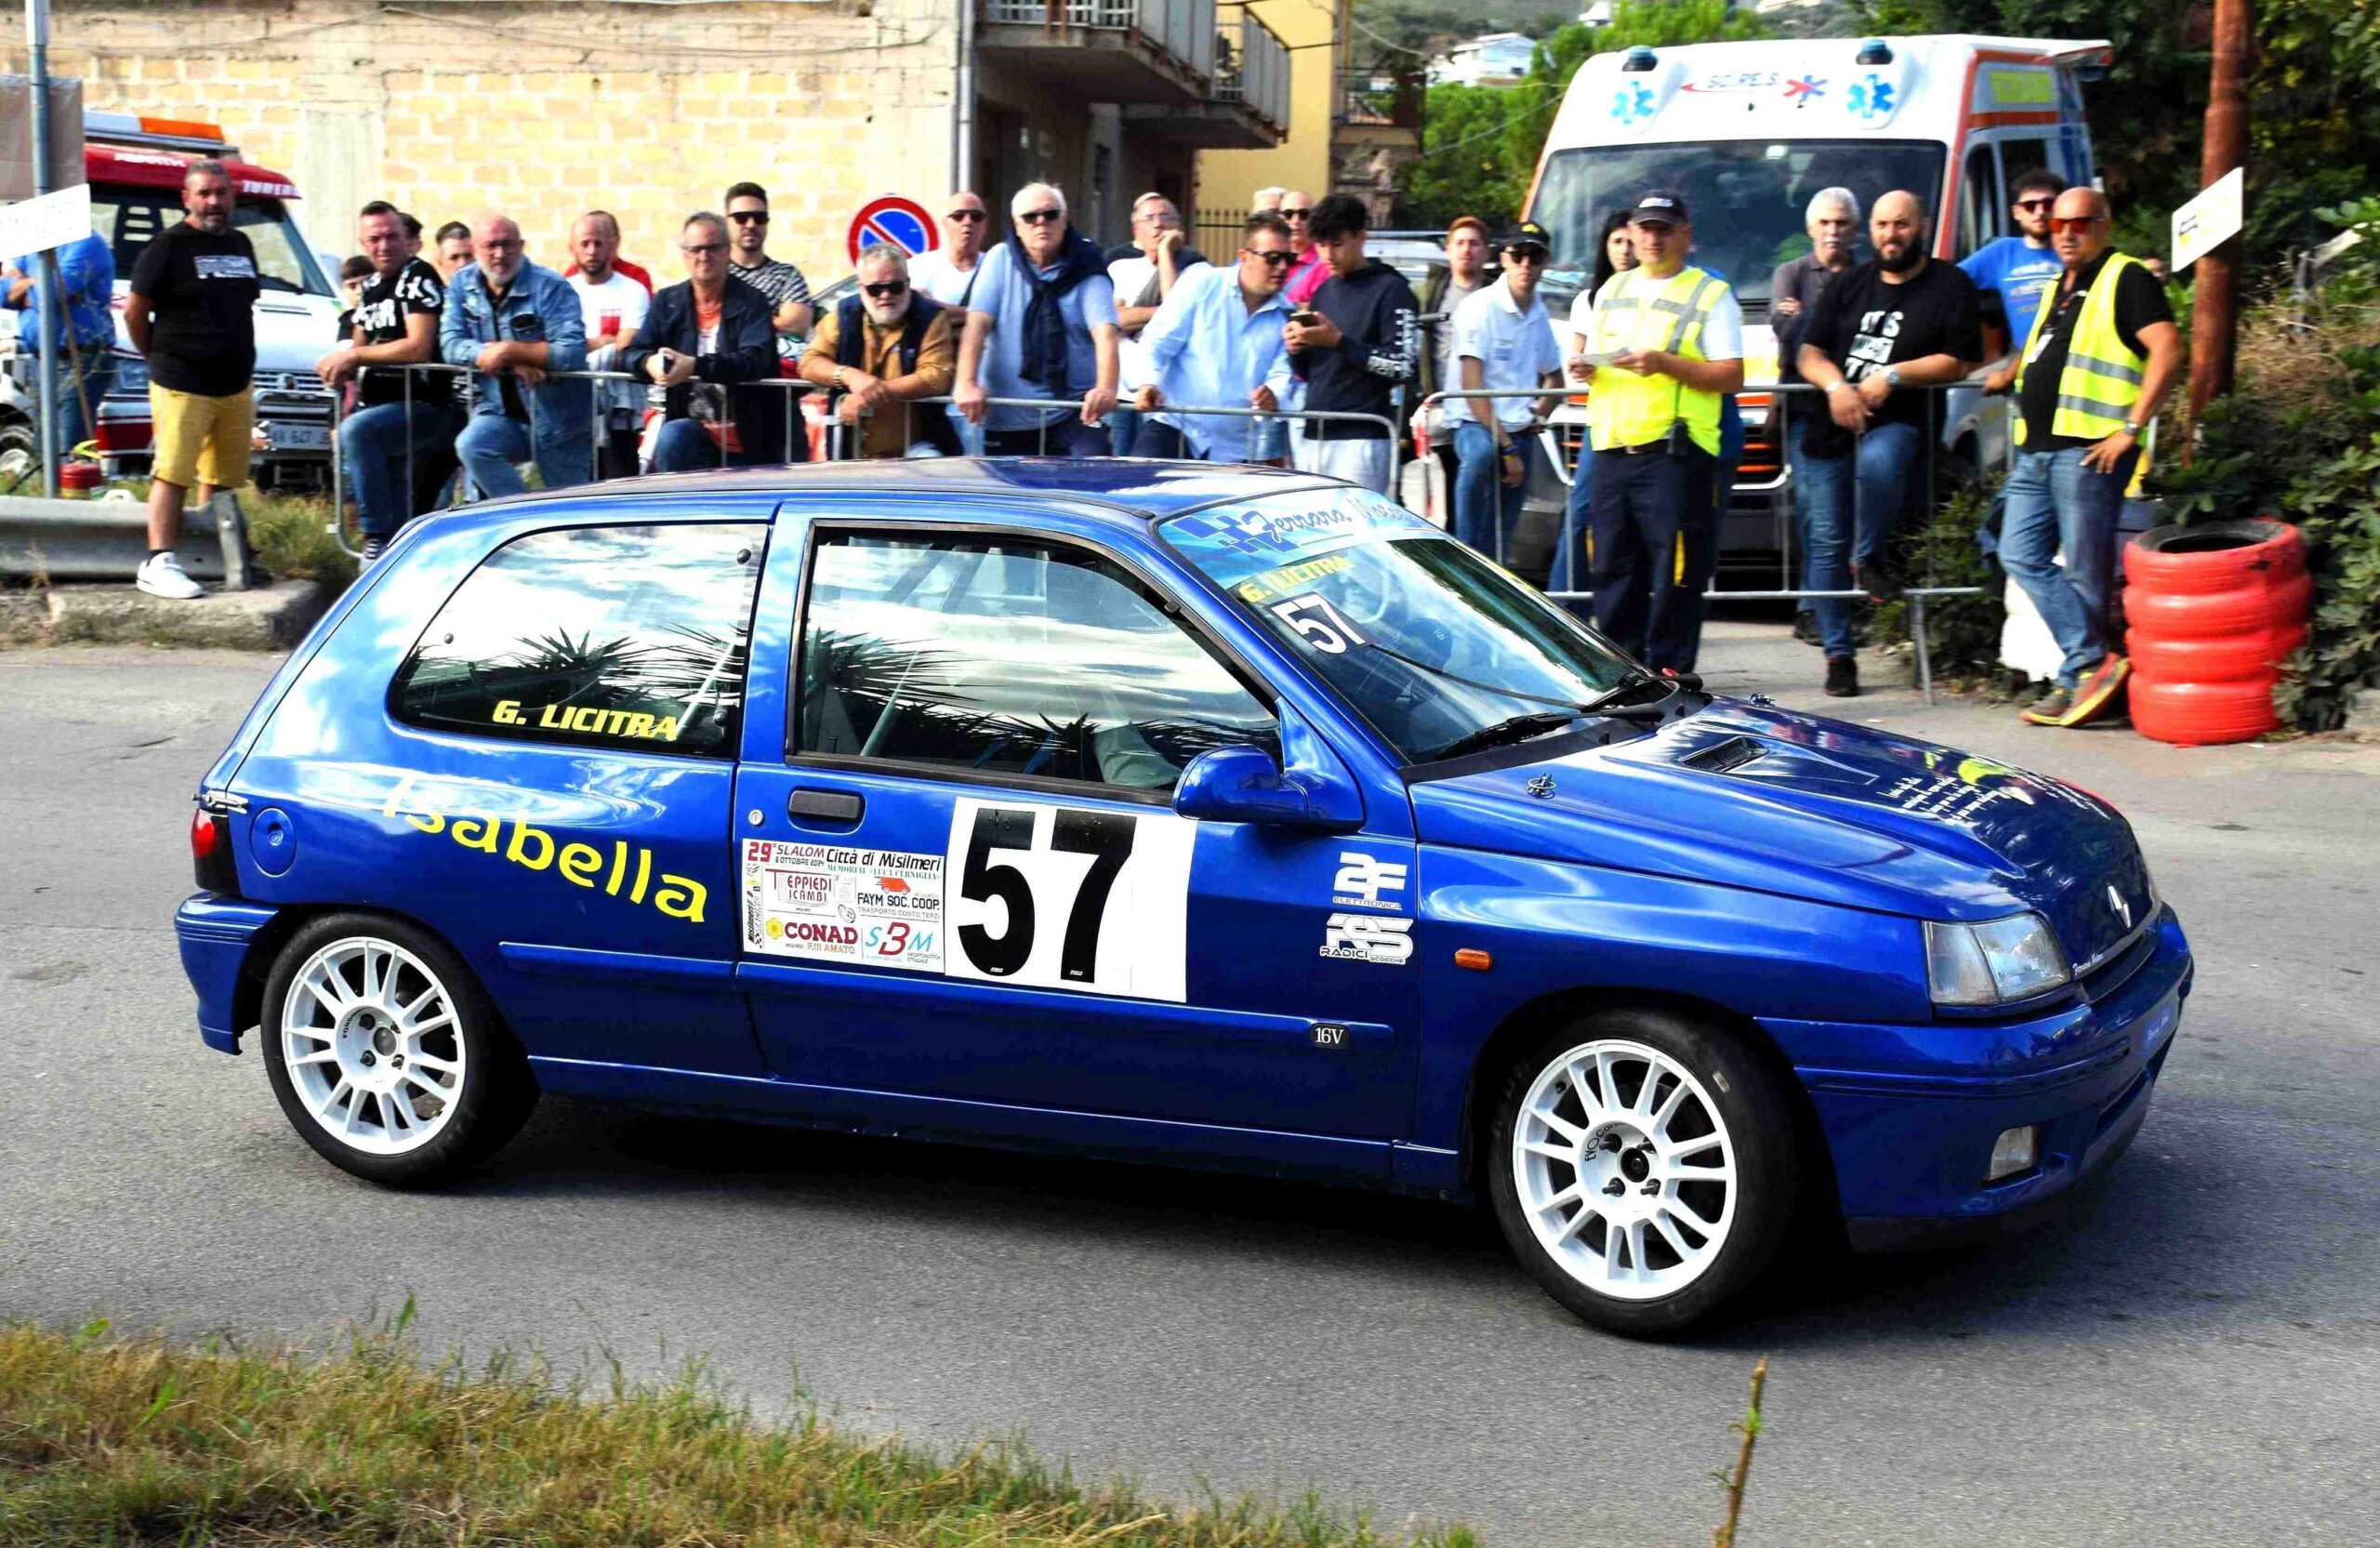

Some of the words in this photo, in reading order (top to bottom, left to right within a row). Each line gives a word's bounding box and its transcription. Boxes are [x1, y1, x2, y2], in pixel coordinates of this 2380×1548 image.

[1268, 555, 1352, 590] LICITRA
[1271, 593, 1366, 654] 57
[493, 700, 526, 725] G.
[539, 705, 678, 742] LICITRA
[776, 844, 825, 858] SLALOM
[826, 848, 857, 865] Città
[862, 853, 874, 866] di
[879, 853, 942, 871] Misilmeri
[857, 893, 883, 906] FAYM
[887, 895, 910, 908] SOC.
[912, 898, 940, 911] COOP.
[958, 806, 1137, 984] 57
[1333, 896, 1402, 910] ELETTRONICA
[858, 906, 896, 915] TRASPORTO
[898, 909, 920, 918] CONTO
[785, 922, 858, 945] CONAD
[1320, 946, 1368, 959] RADICI
[1369, 955, 1404, 963] SCOCCHE
[1315, 1026, 1344, 1044] 16V
